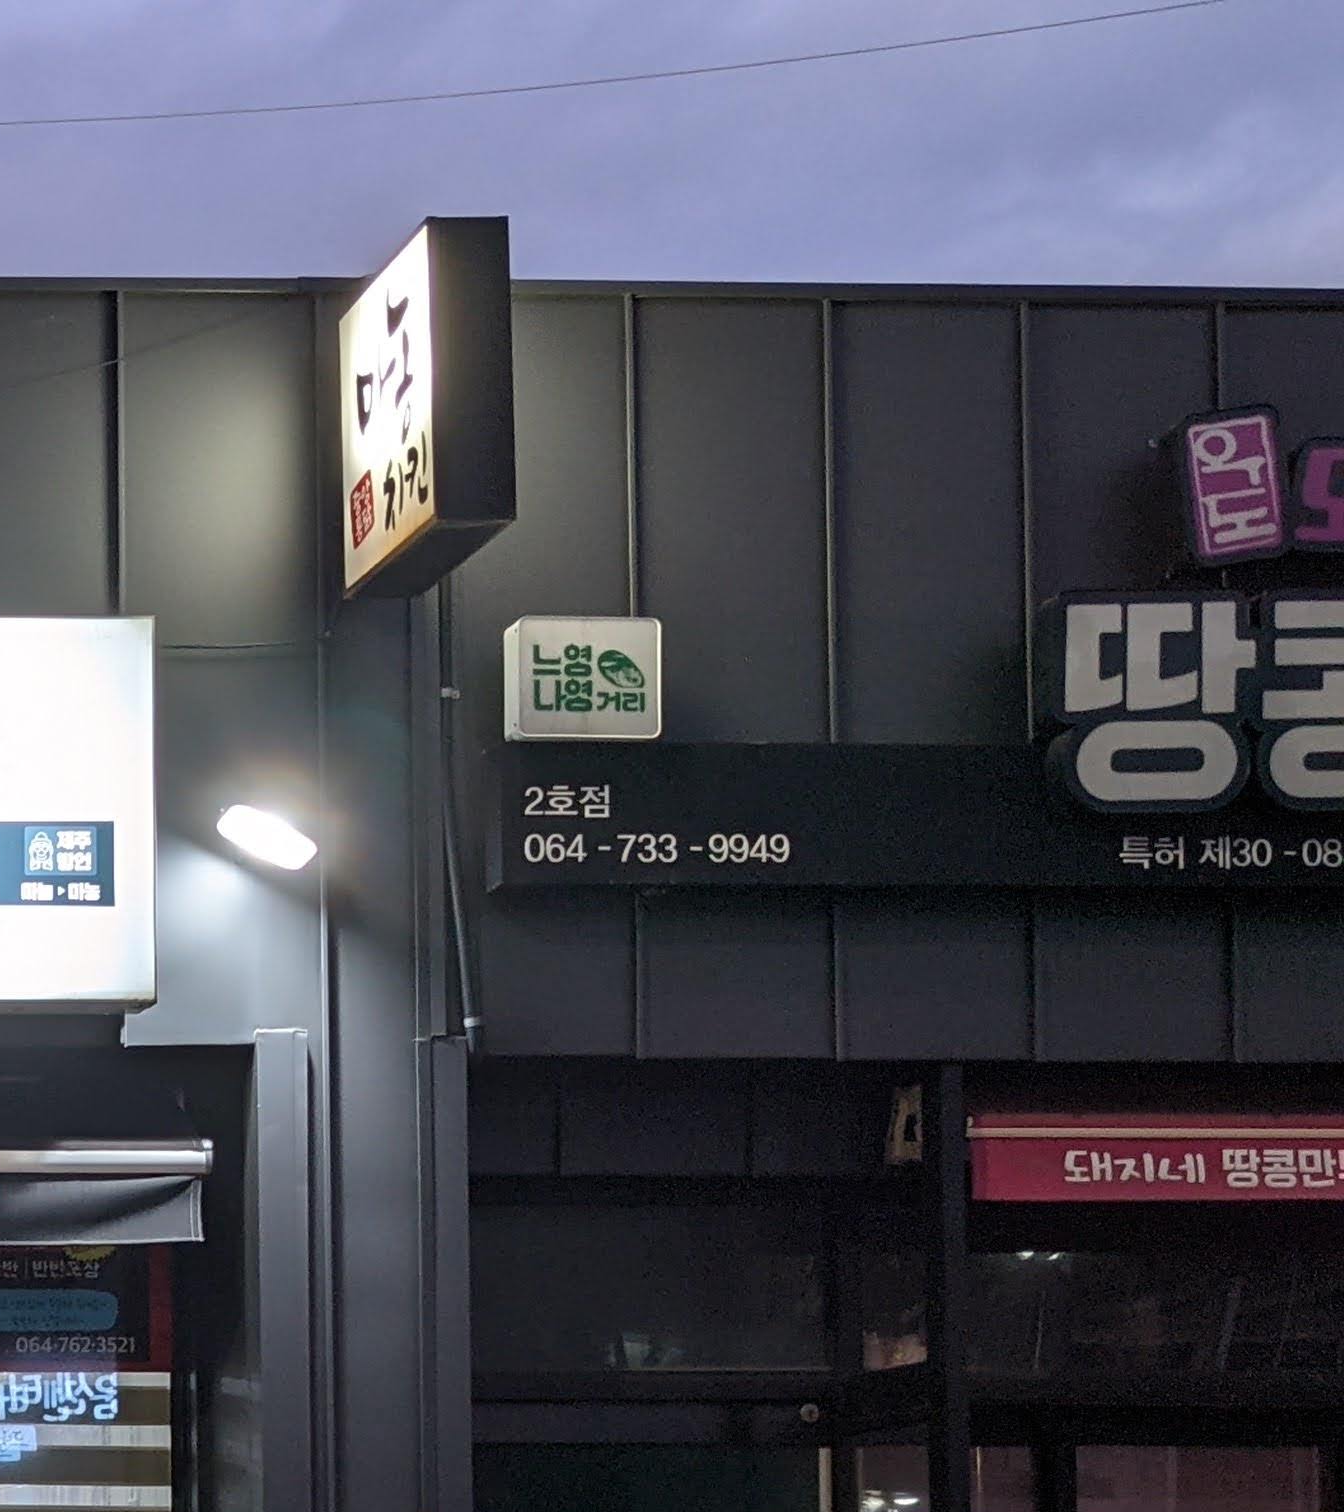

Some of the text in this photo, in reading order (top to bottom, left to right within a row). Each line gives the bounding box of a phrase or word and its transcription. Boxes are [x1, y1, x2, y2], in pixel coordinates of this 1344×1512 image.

[381, 430, 429, 532] 치킨
[532, 643, 594, 678] 느영
[523, 785, 611, 818] 2호점
[1118, 836, 1185, 870] 특허
[1064, 1148, 1206, 1185] 돼지네
